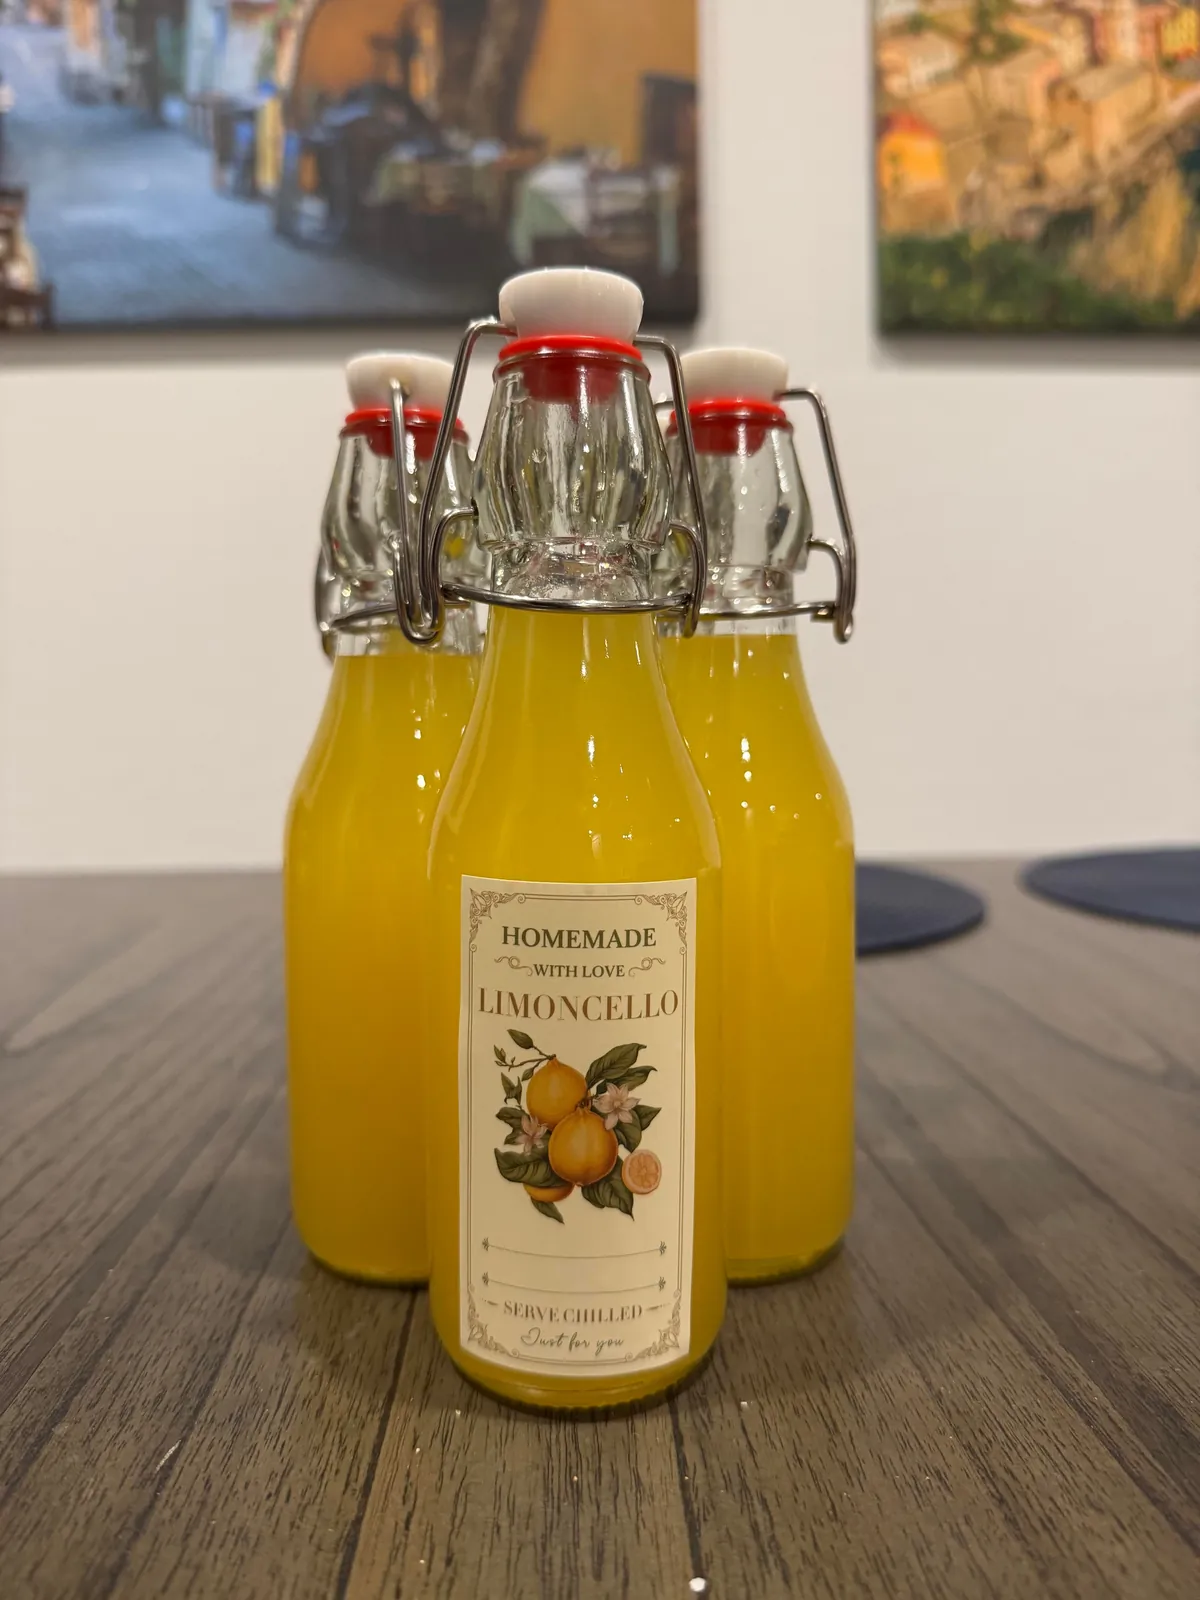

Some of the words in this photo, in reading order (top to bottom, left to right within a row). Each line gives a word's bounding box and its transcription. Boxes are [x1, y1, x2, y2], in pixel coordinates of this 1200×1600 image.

[501, 925, 657, 949] HOMEMADE
[533, 963, 577, 978] WITH
[582, 965, 625, 978] LOVE
[478, 986, 679, 1021] LIMONCELLO
[503, 1300, 560, 1322] SERVE
[563, 1304, 643, 1323] CHILLED
[520, 1326, 568, 1347] Just
[568, 1331, 591, 1352] for
[596, 1338, 625, 1356] you
